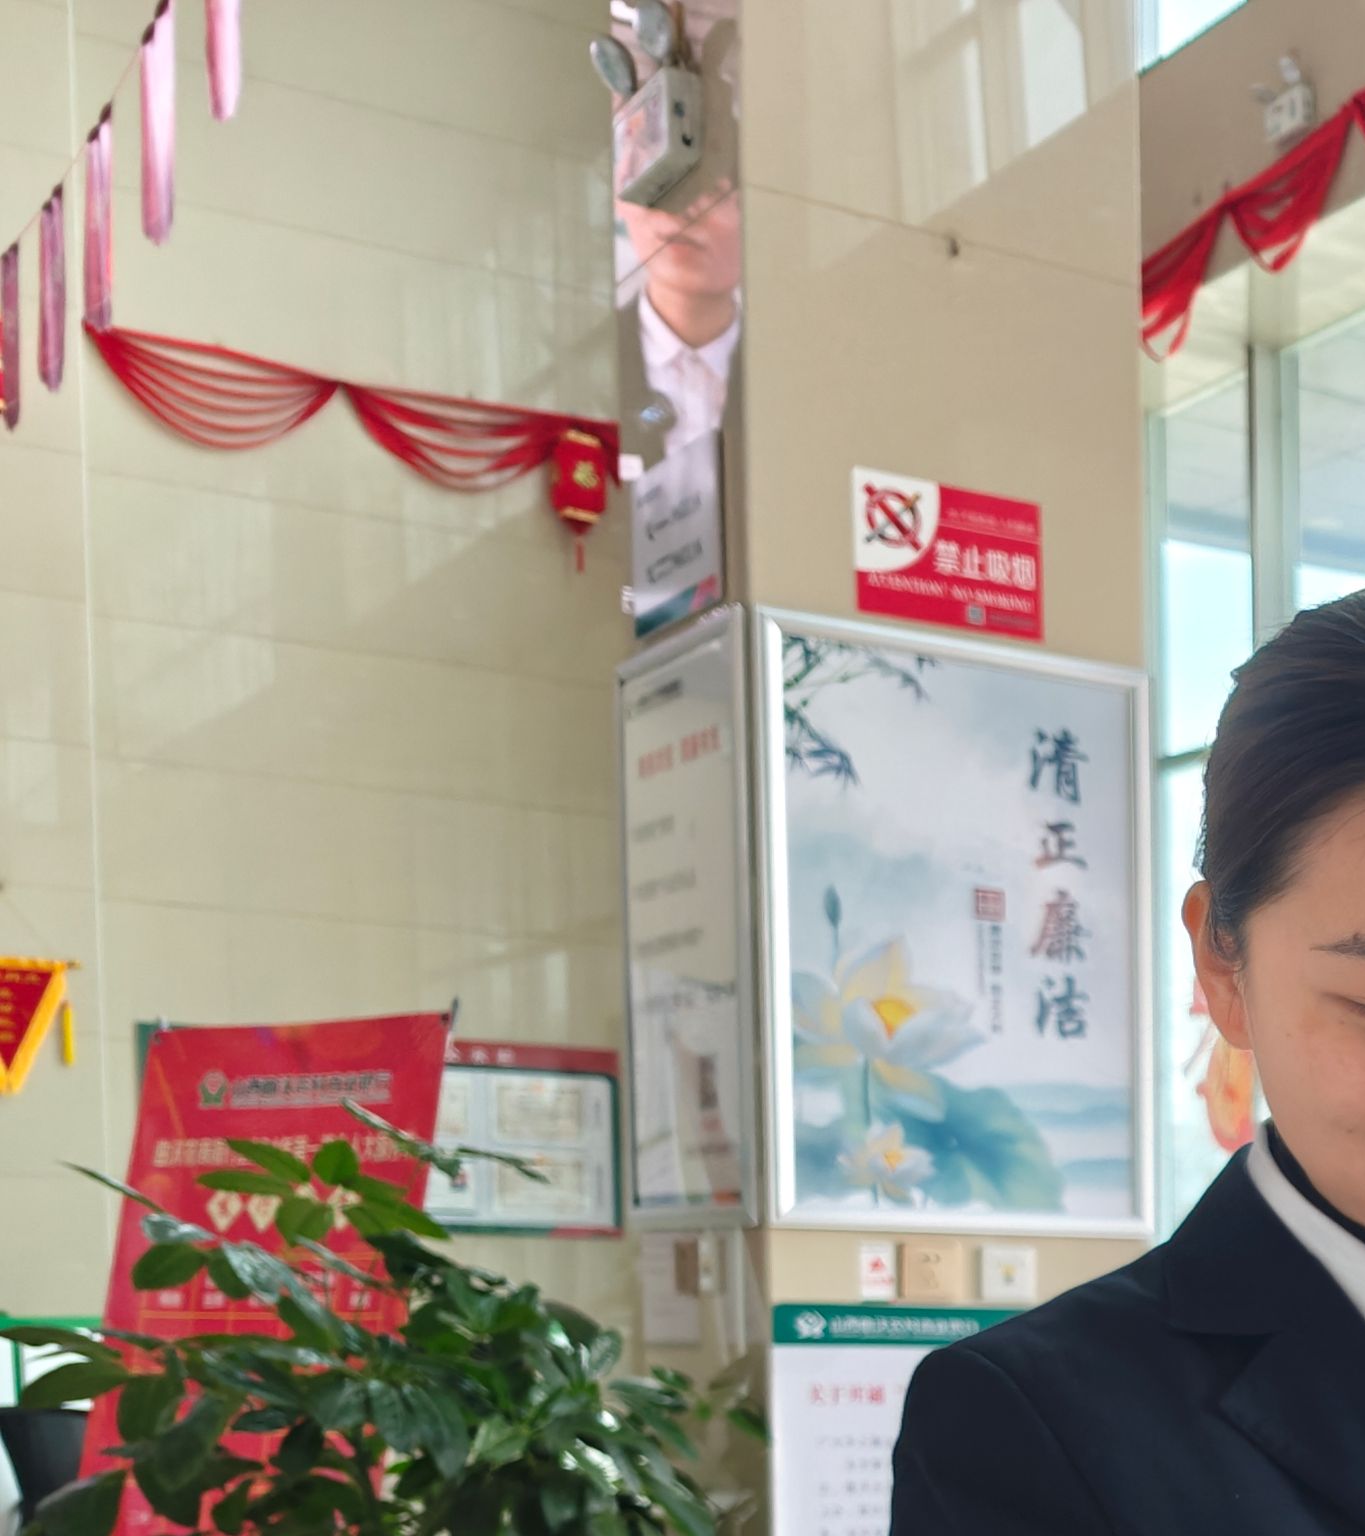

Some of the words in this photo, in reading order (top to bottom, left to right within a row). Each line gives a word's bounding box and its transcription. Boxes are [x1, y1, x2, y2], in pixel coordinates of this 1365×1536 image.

[933, 539, 1036, 590] 禁止吸烟
[1027, 727, 1089, 1041] 清正廉洁
